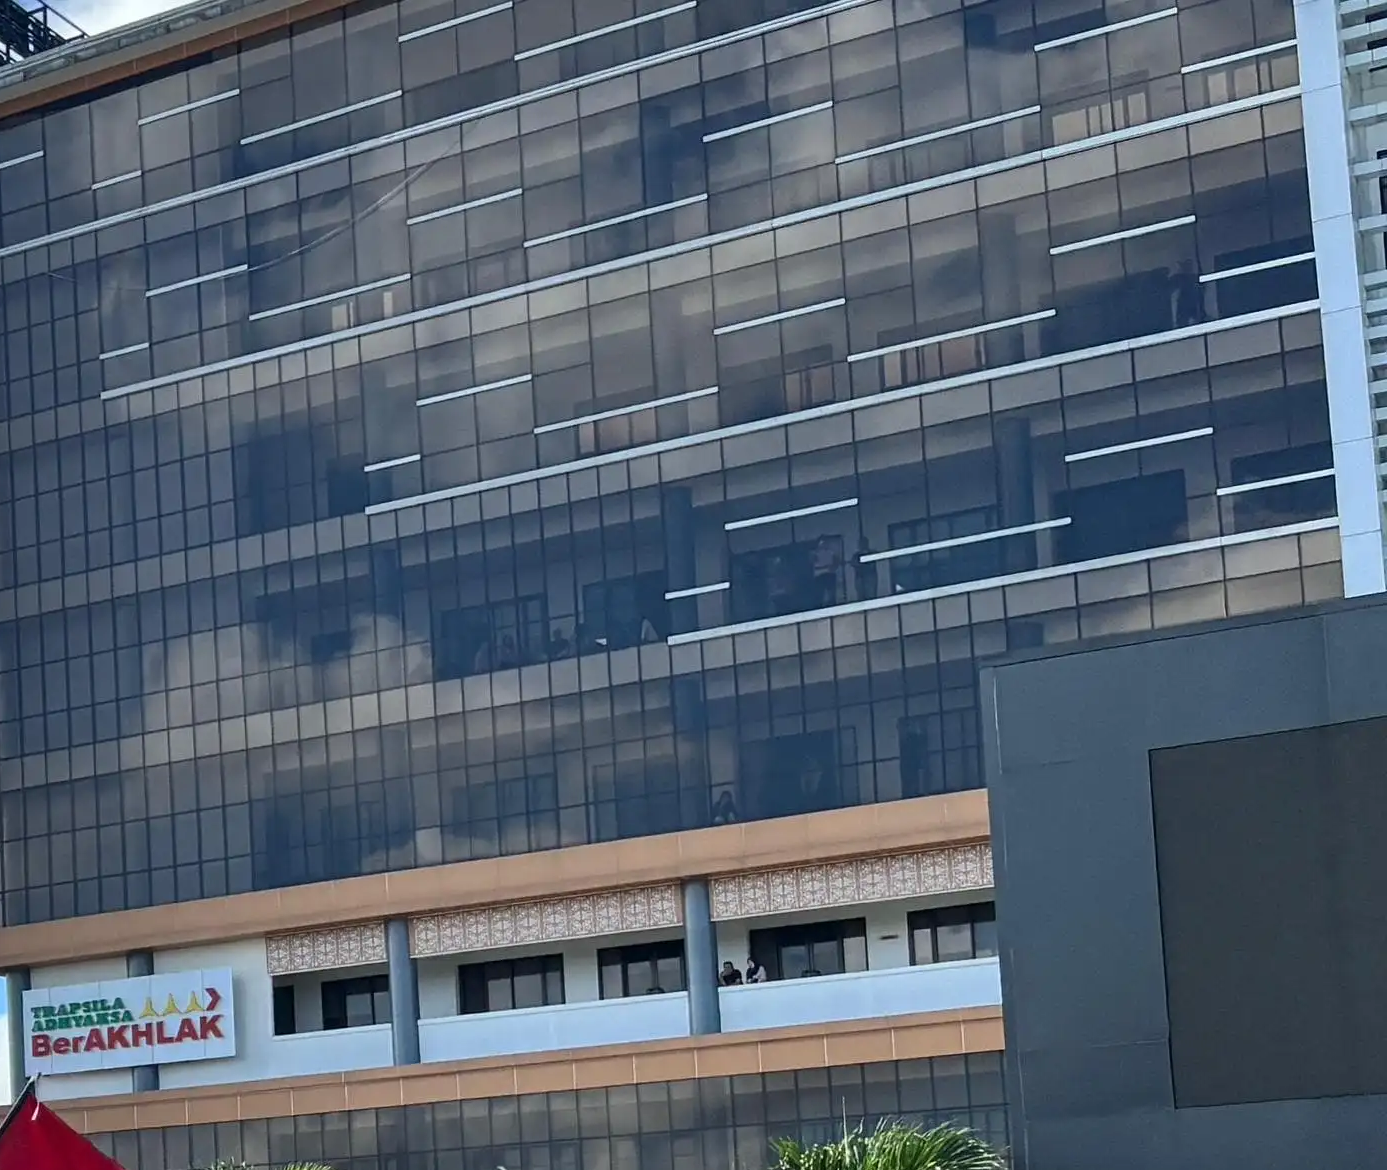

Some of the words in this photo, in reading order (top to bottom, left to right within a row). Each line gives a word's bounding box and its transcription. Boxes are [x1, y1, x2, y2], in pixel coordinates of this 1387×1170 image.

[30, 997, 126, 1019] TRAPSILA
[31, 1010, 135, 1032] ADHYAKSA
[31, 1014, 225, 1057] BerAKHLAK
